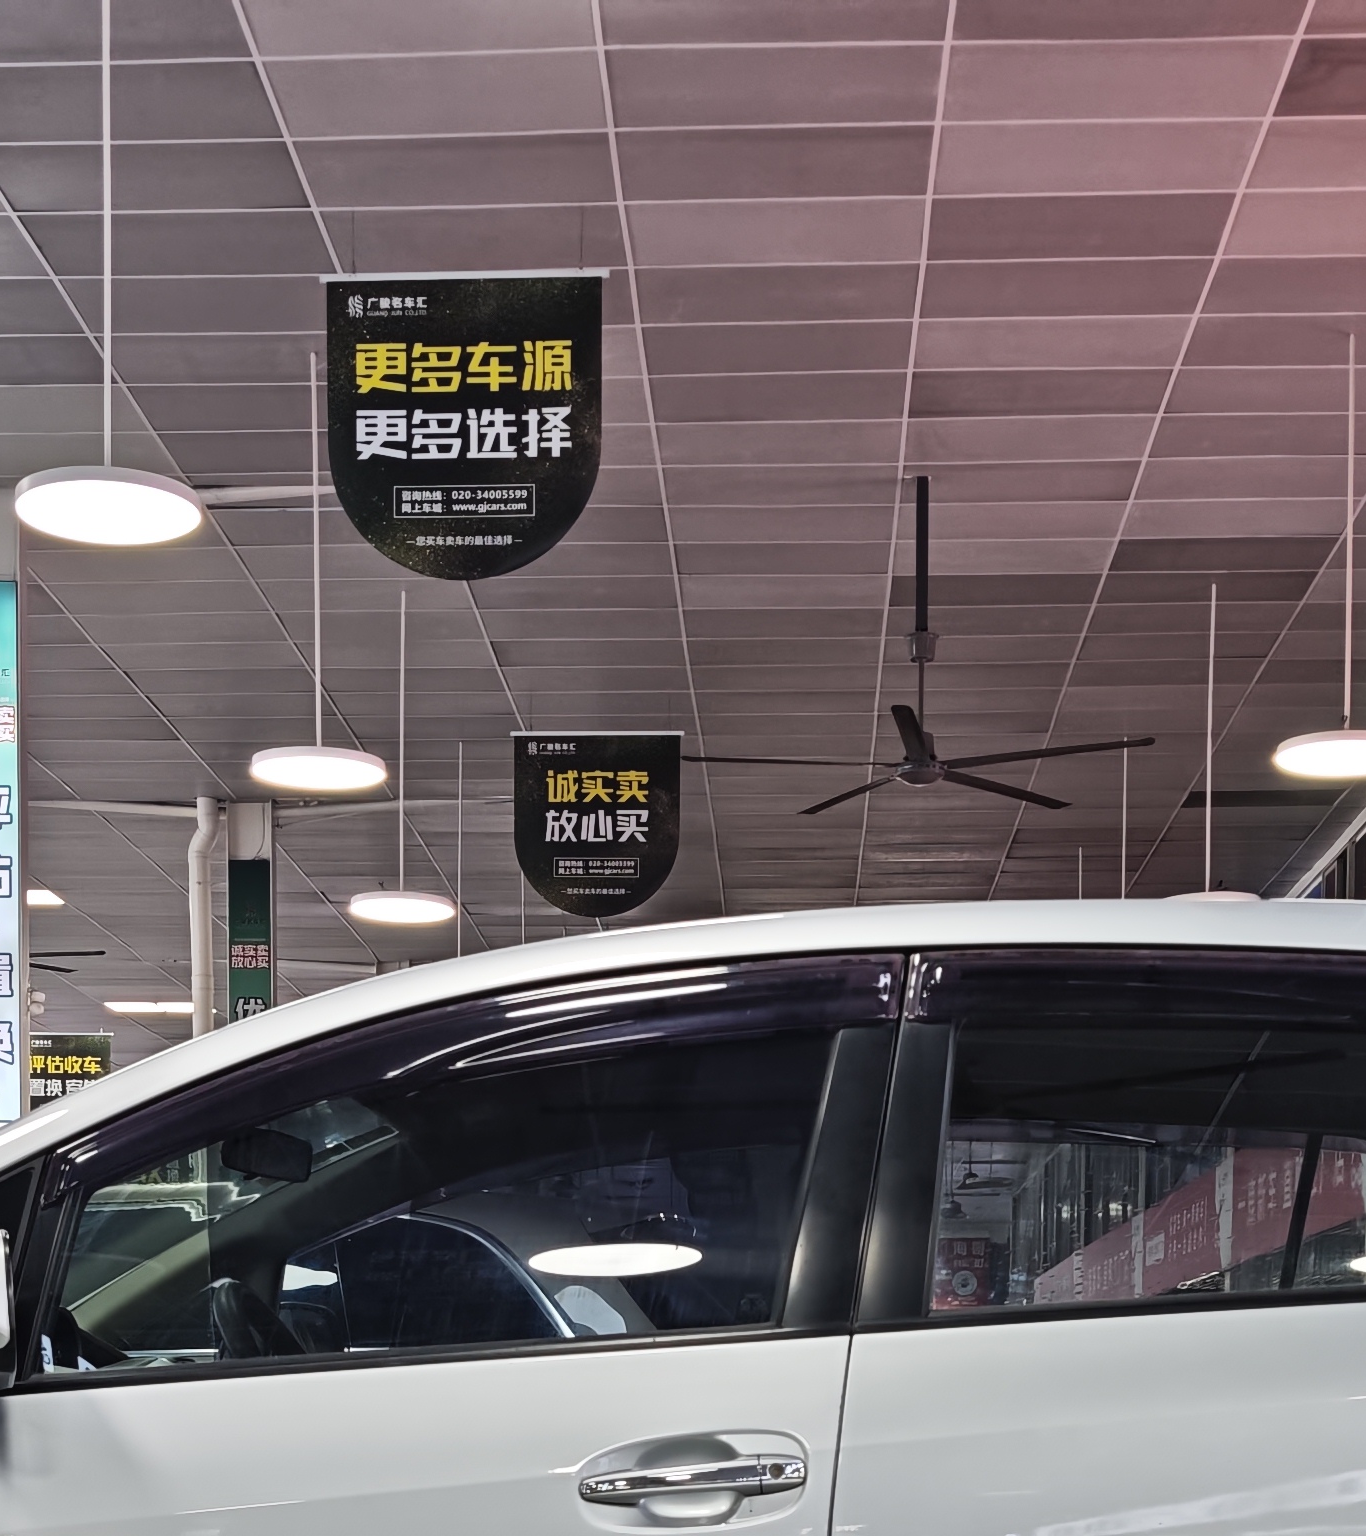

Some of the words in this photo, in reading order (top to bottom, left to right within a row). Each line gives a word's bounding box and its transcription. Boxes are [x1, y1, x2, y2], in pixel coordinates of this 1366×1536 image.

[355, 339, 573, 394] 更多车源
[355, 405, 573, 461] 更多选择
[546, 769, 649, 803] 诚实卖
[544, 809, 649, 843] 放心买
[231, 944, 269, 957] 诚实卖
[231, 956, 269, 969] 放心买
[235, 997, 267, 1021] 优
[30, 1055, 102, 1074] 评估收车
